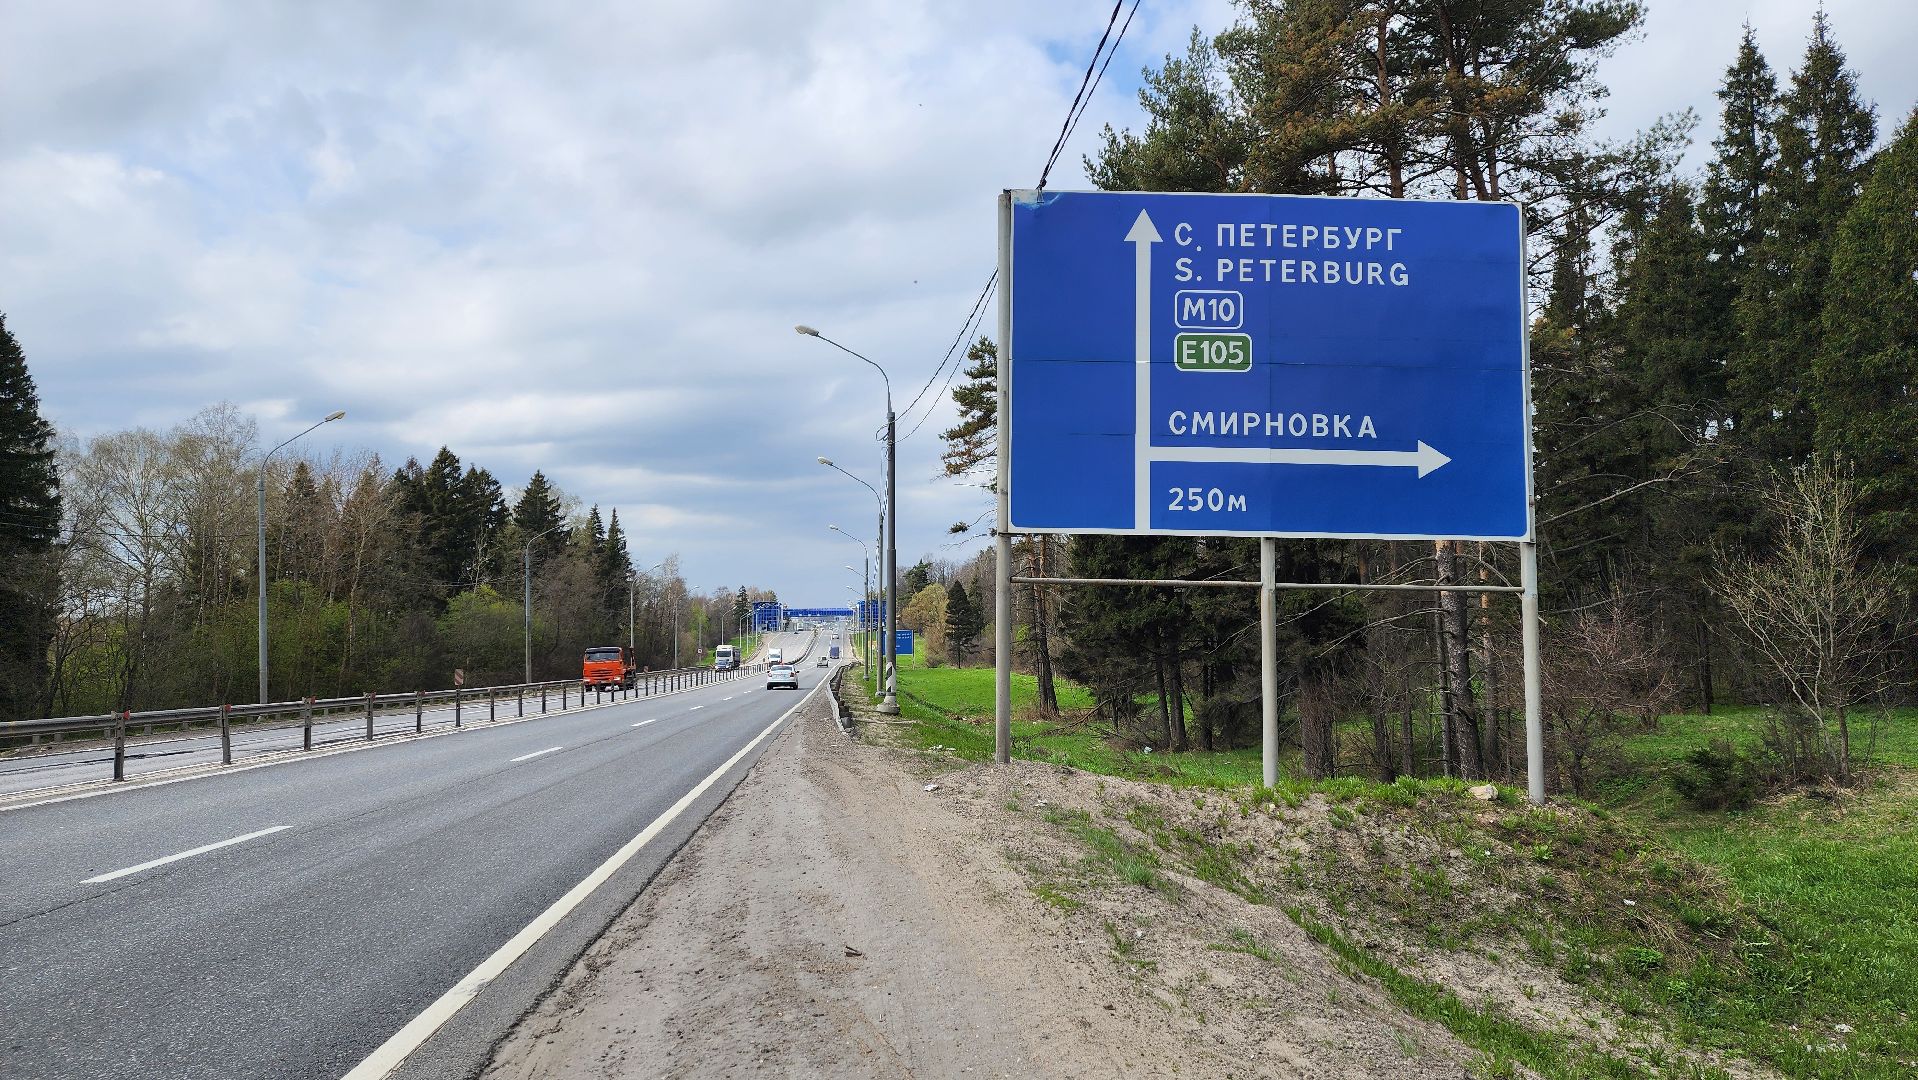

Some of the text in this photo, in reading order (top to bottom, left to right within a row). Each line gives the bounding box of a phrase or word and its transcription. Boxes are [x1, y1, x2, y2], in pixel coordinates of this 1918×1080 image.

[1174, 222, 1402, 252] С. ПЕТЕРБУРГ
[1174, 257, 1409, 286] S. PETERBURG
[1182, 340, 1244, 365] E105
[1168, 410, 1377, 439] СМИРНОВКА
